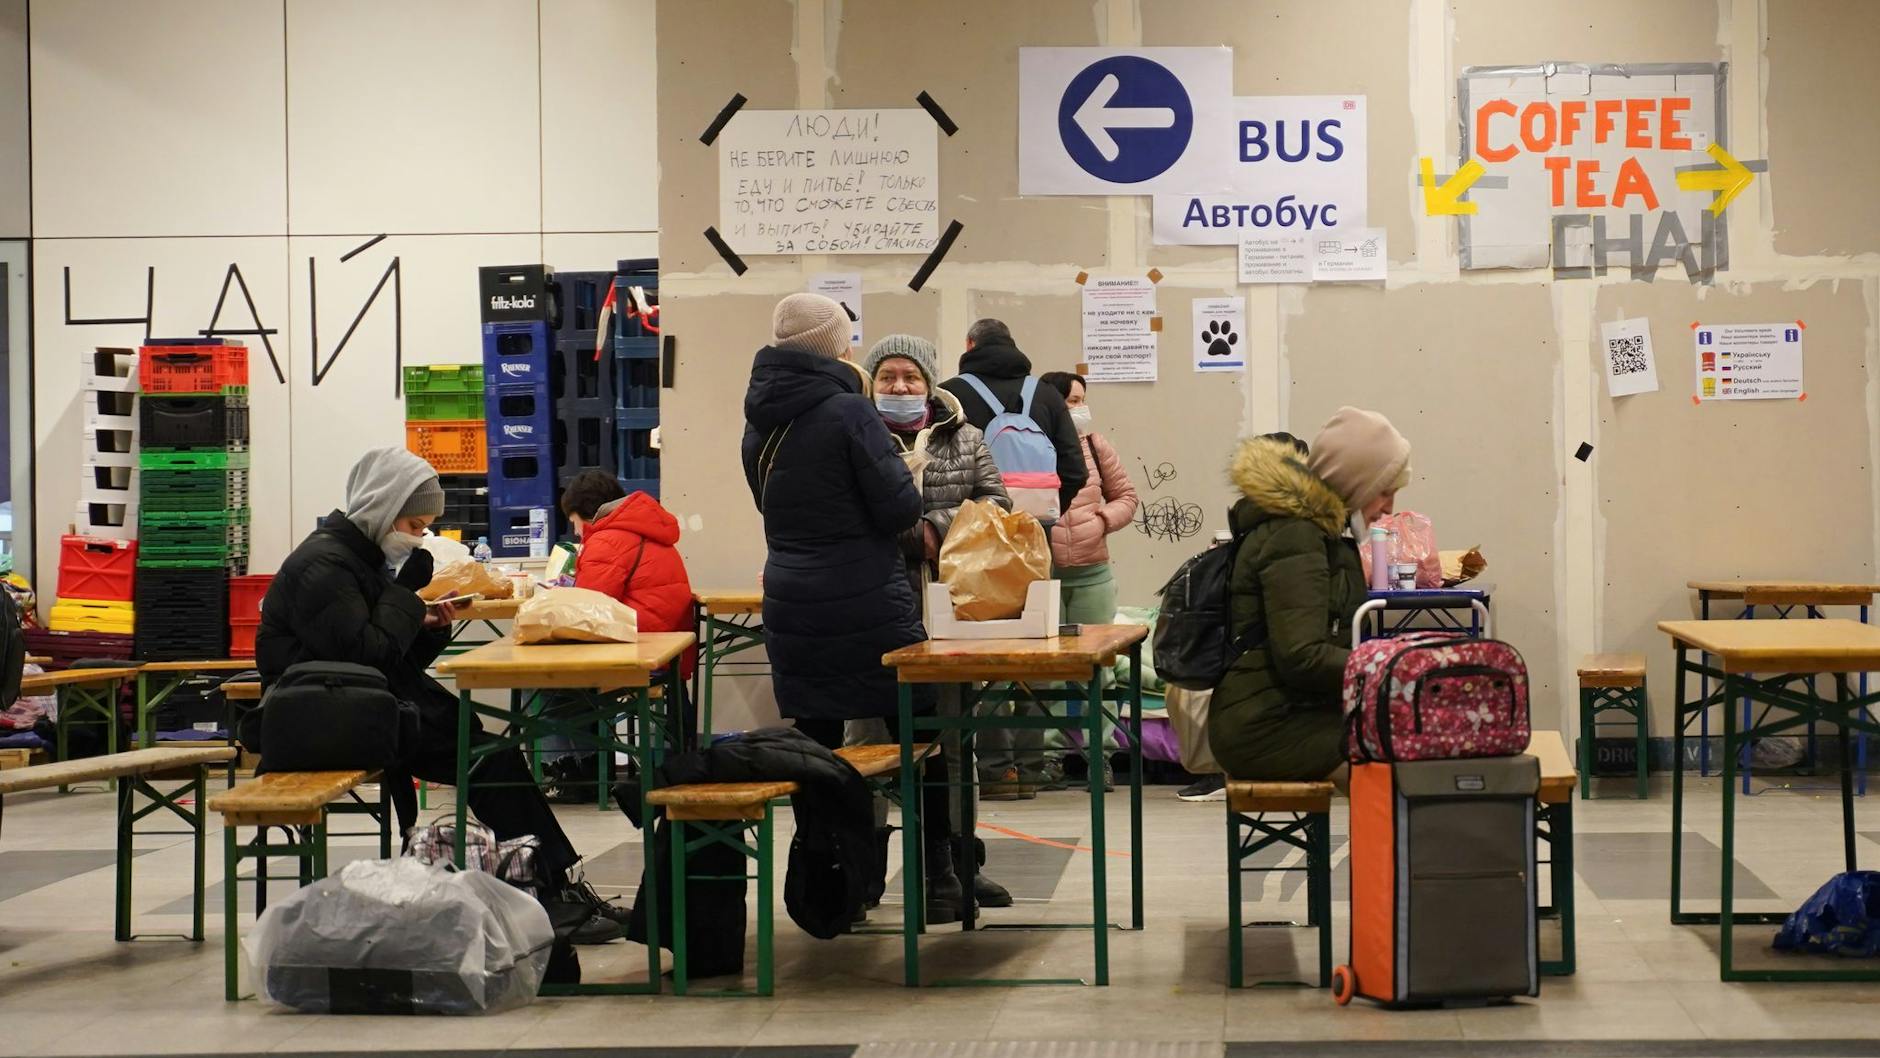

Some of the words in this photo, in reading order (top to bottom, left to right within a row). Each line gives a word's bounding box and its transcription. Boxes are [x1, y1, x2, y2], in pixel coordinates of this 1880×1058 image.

[787, 113, 879, 142] ЛЮДИ!
[1476, 97, 1692, 163] COFFEE
[1239, 119, 1344, 163] BUS
[730, 151, 749, 167] НЕ
[757, 151, 815, 167] БЕРИТЕ
[830, 150, 909, 166] ЛИШНЮЮ
[784, 178, 792, 192] И
[1544, 156, 1660, 211] TEA
[1183, 195, 1338, 230] Автобус
[734, 223, 746, 237] И
[776, 240, 794, 252] ЗА
[1551, 209, 1716, 285] CHAI
[491, 295, 535, 310] fritz-kola
[64, 233, 400, 400] ЧАЙ
[1733, 363, 1762, 371] Русский
[1733, 387, 1760, 395] English
